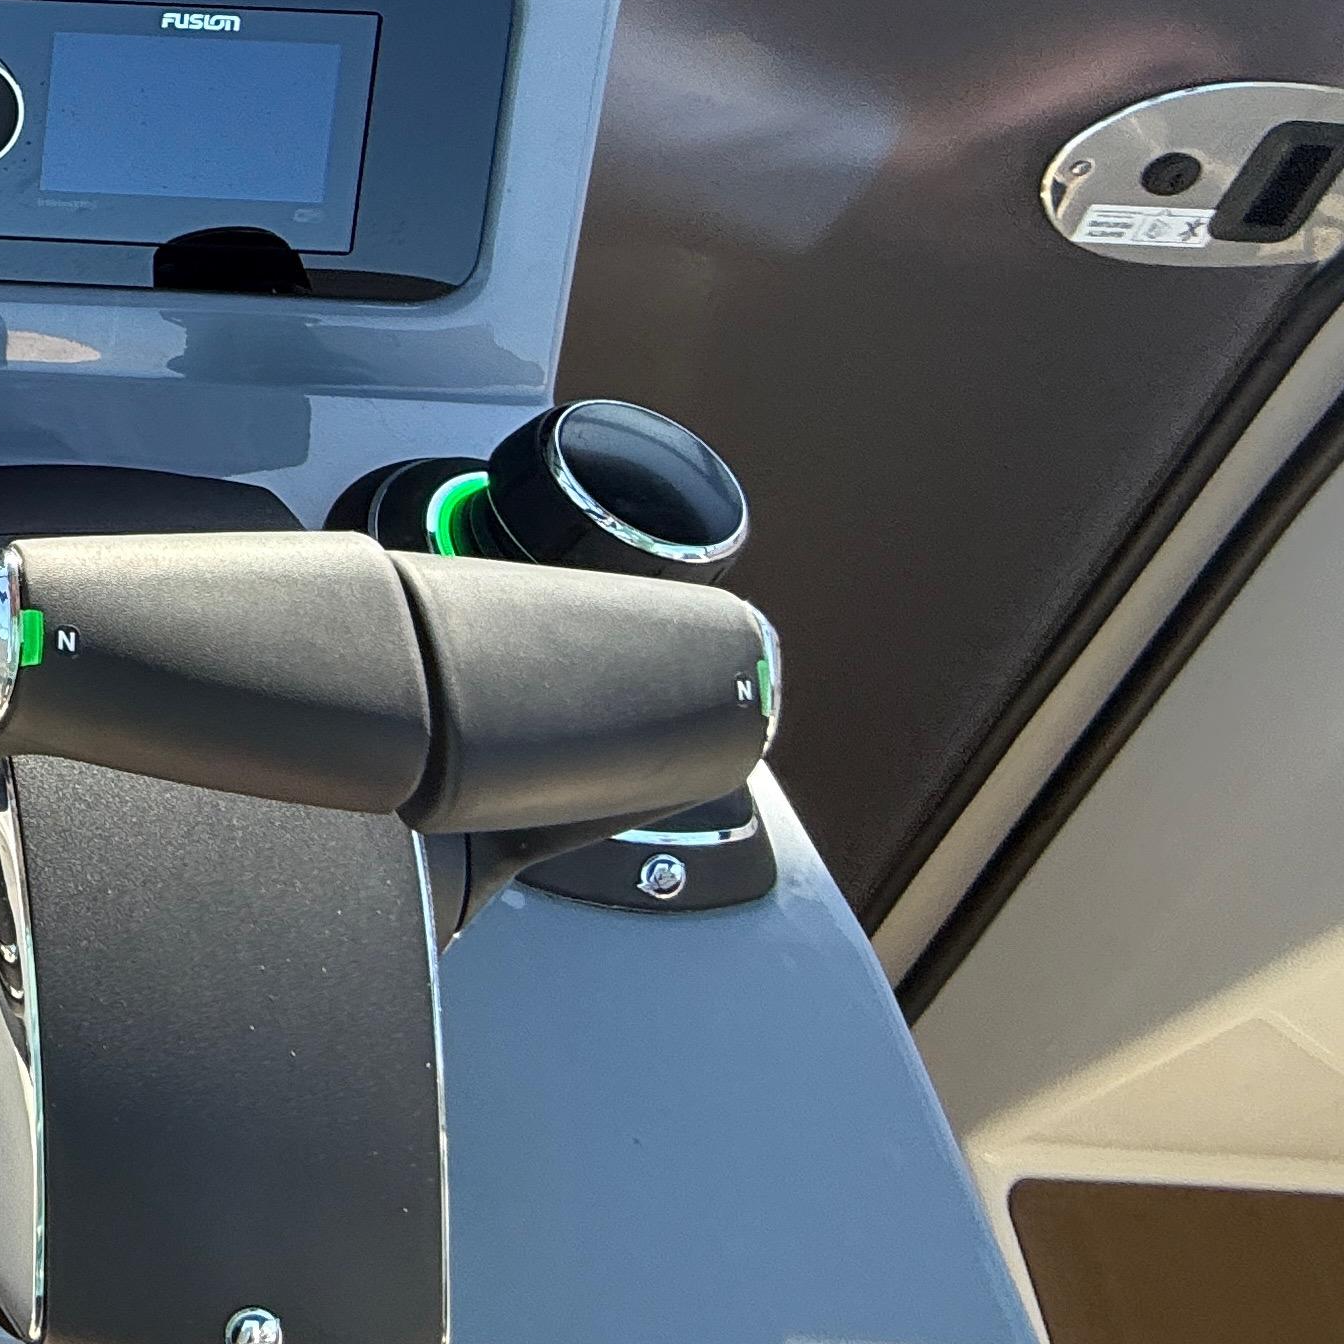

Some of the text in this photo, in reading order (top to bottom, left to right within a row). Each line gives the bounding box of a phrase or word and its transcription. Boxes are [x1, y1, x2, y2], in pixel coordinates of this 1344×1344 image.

[161, 12, 241, 32] FUSION
[58, 630, 76, 652] N
[736, 680, 752, 701] N
